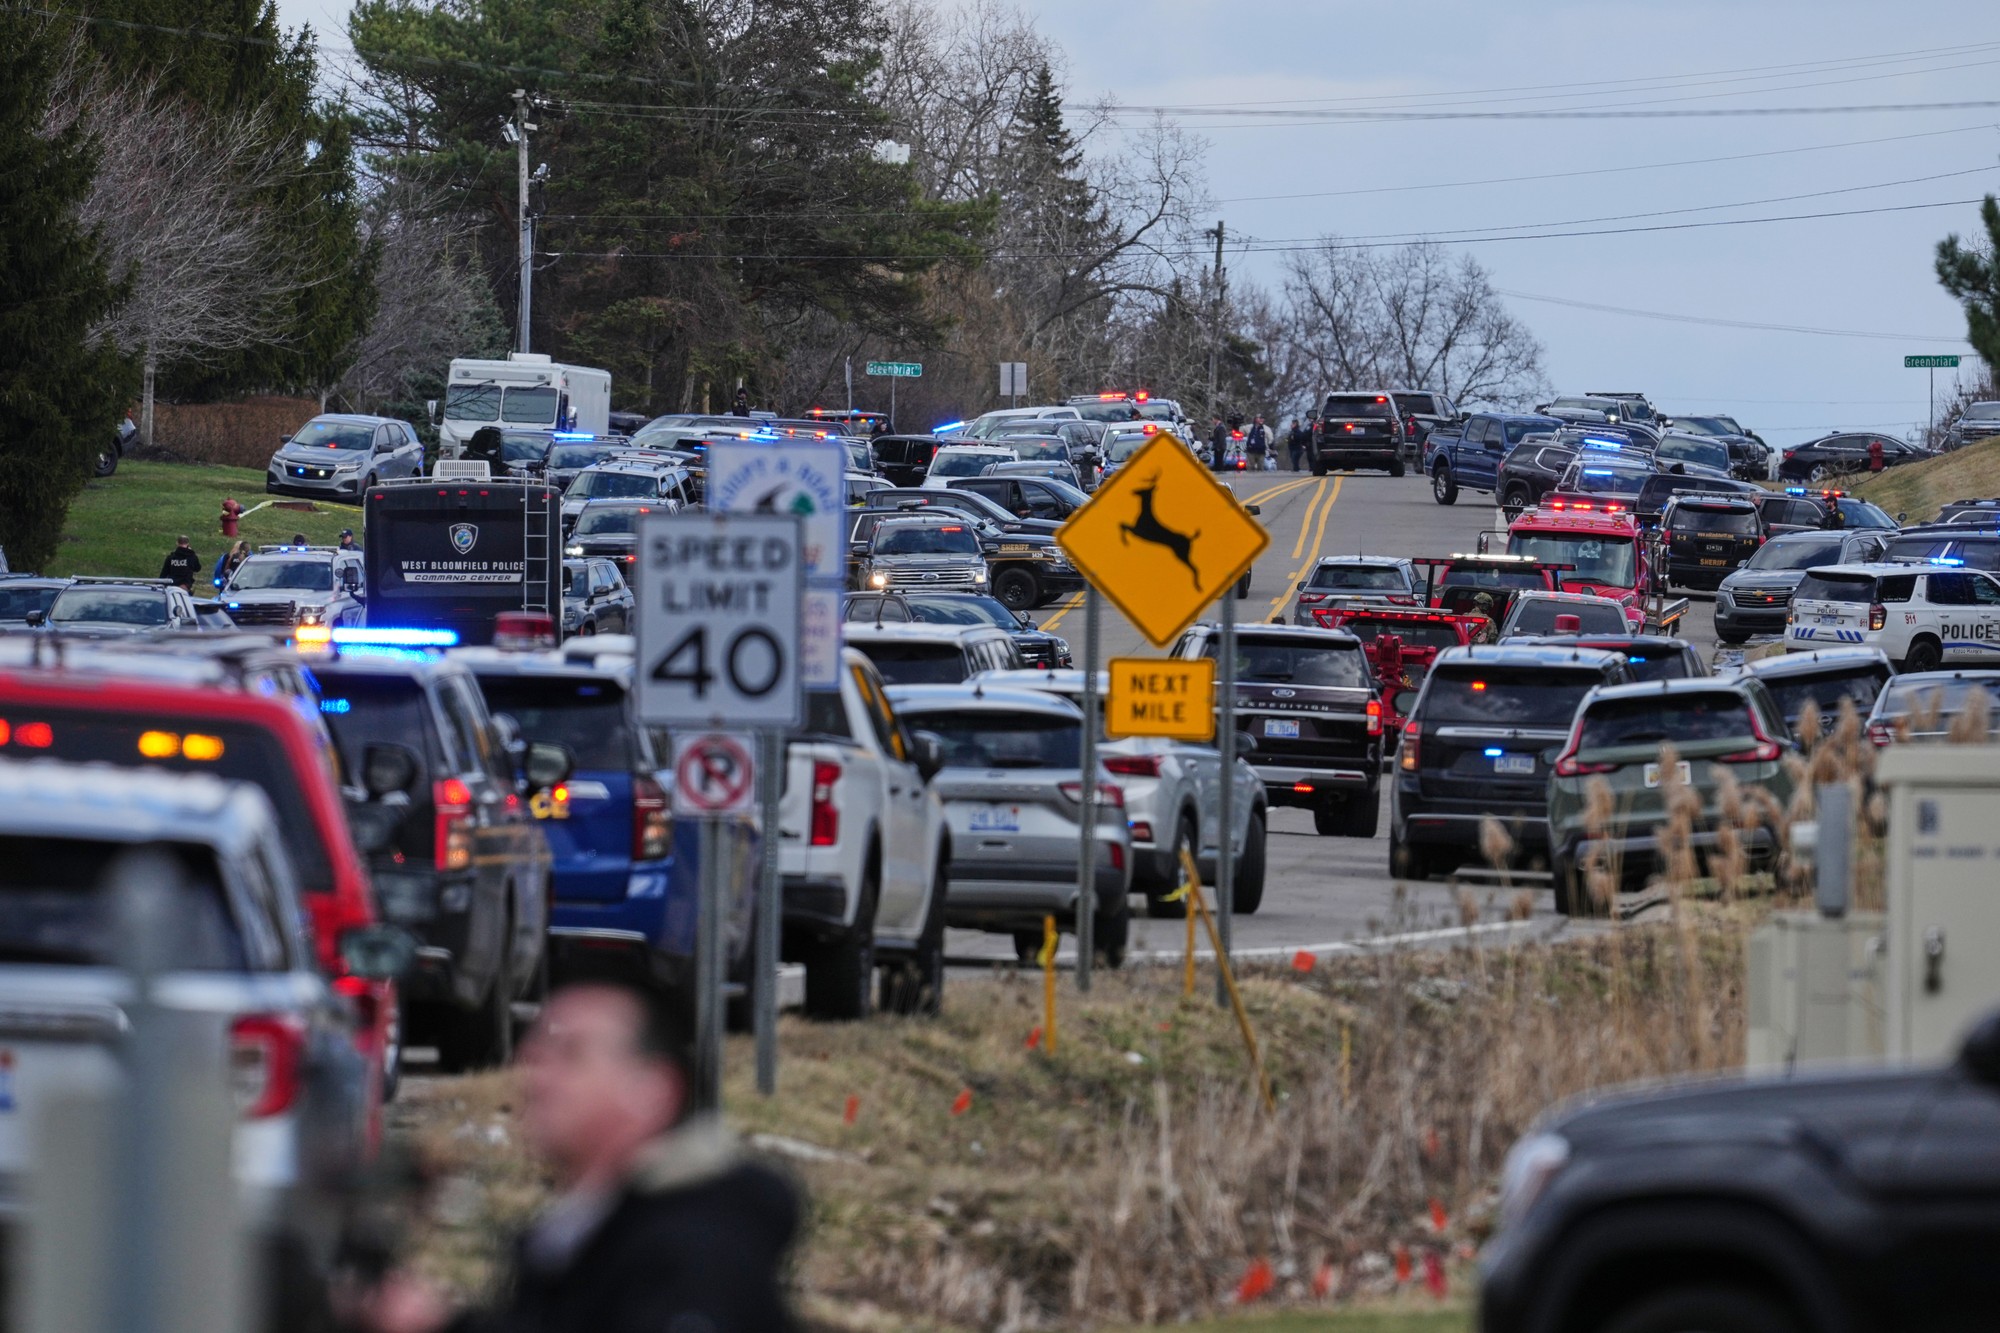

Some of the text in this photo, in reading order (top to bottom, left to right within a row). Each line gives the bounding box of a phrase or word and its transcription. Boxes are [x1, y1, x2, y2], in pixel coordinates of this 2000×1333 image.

[1905, 357, 1953, 367] Greenbriar
[869, 363, 914, 375] Greenbriar
[651, 536, 791, 571] SPEED
[171, 559, 188, 567] POLICE
[402, 561, 524, 571] WEST BLOOMFIELD POLICE
[1700, 558, 1727, 566] SHERIFF
[661, 580, 774, 614] LIMIT
[1859, 618, 1868, 627] 911
[1905, 614, 1917, 625] 911
[1941, 624, 1994, 640] POLICE
[650, 623, 785, 697] 40
[1130, 674, 1190, 694] NEXT
[1131, 702, 1186, 722] MILE
